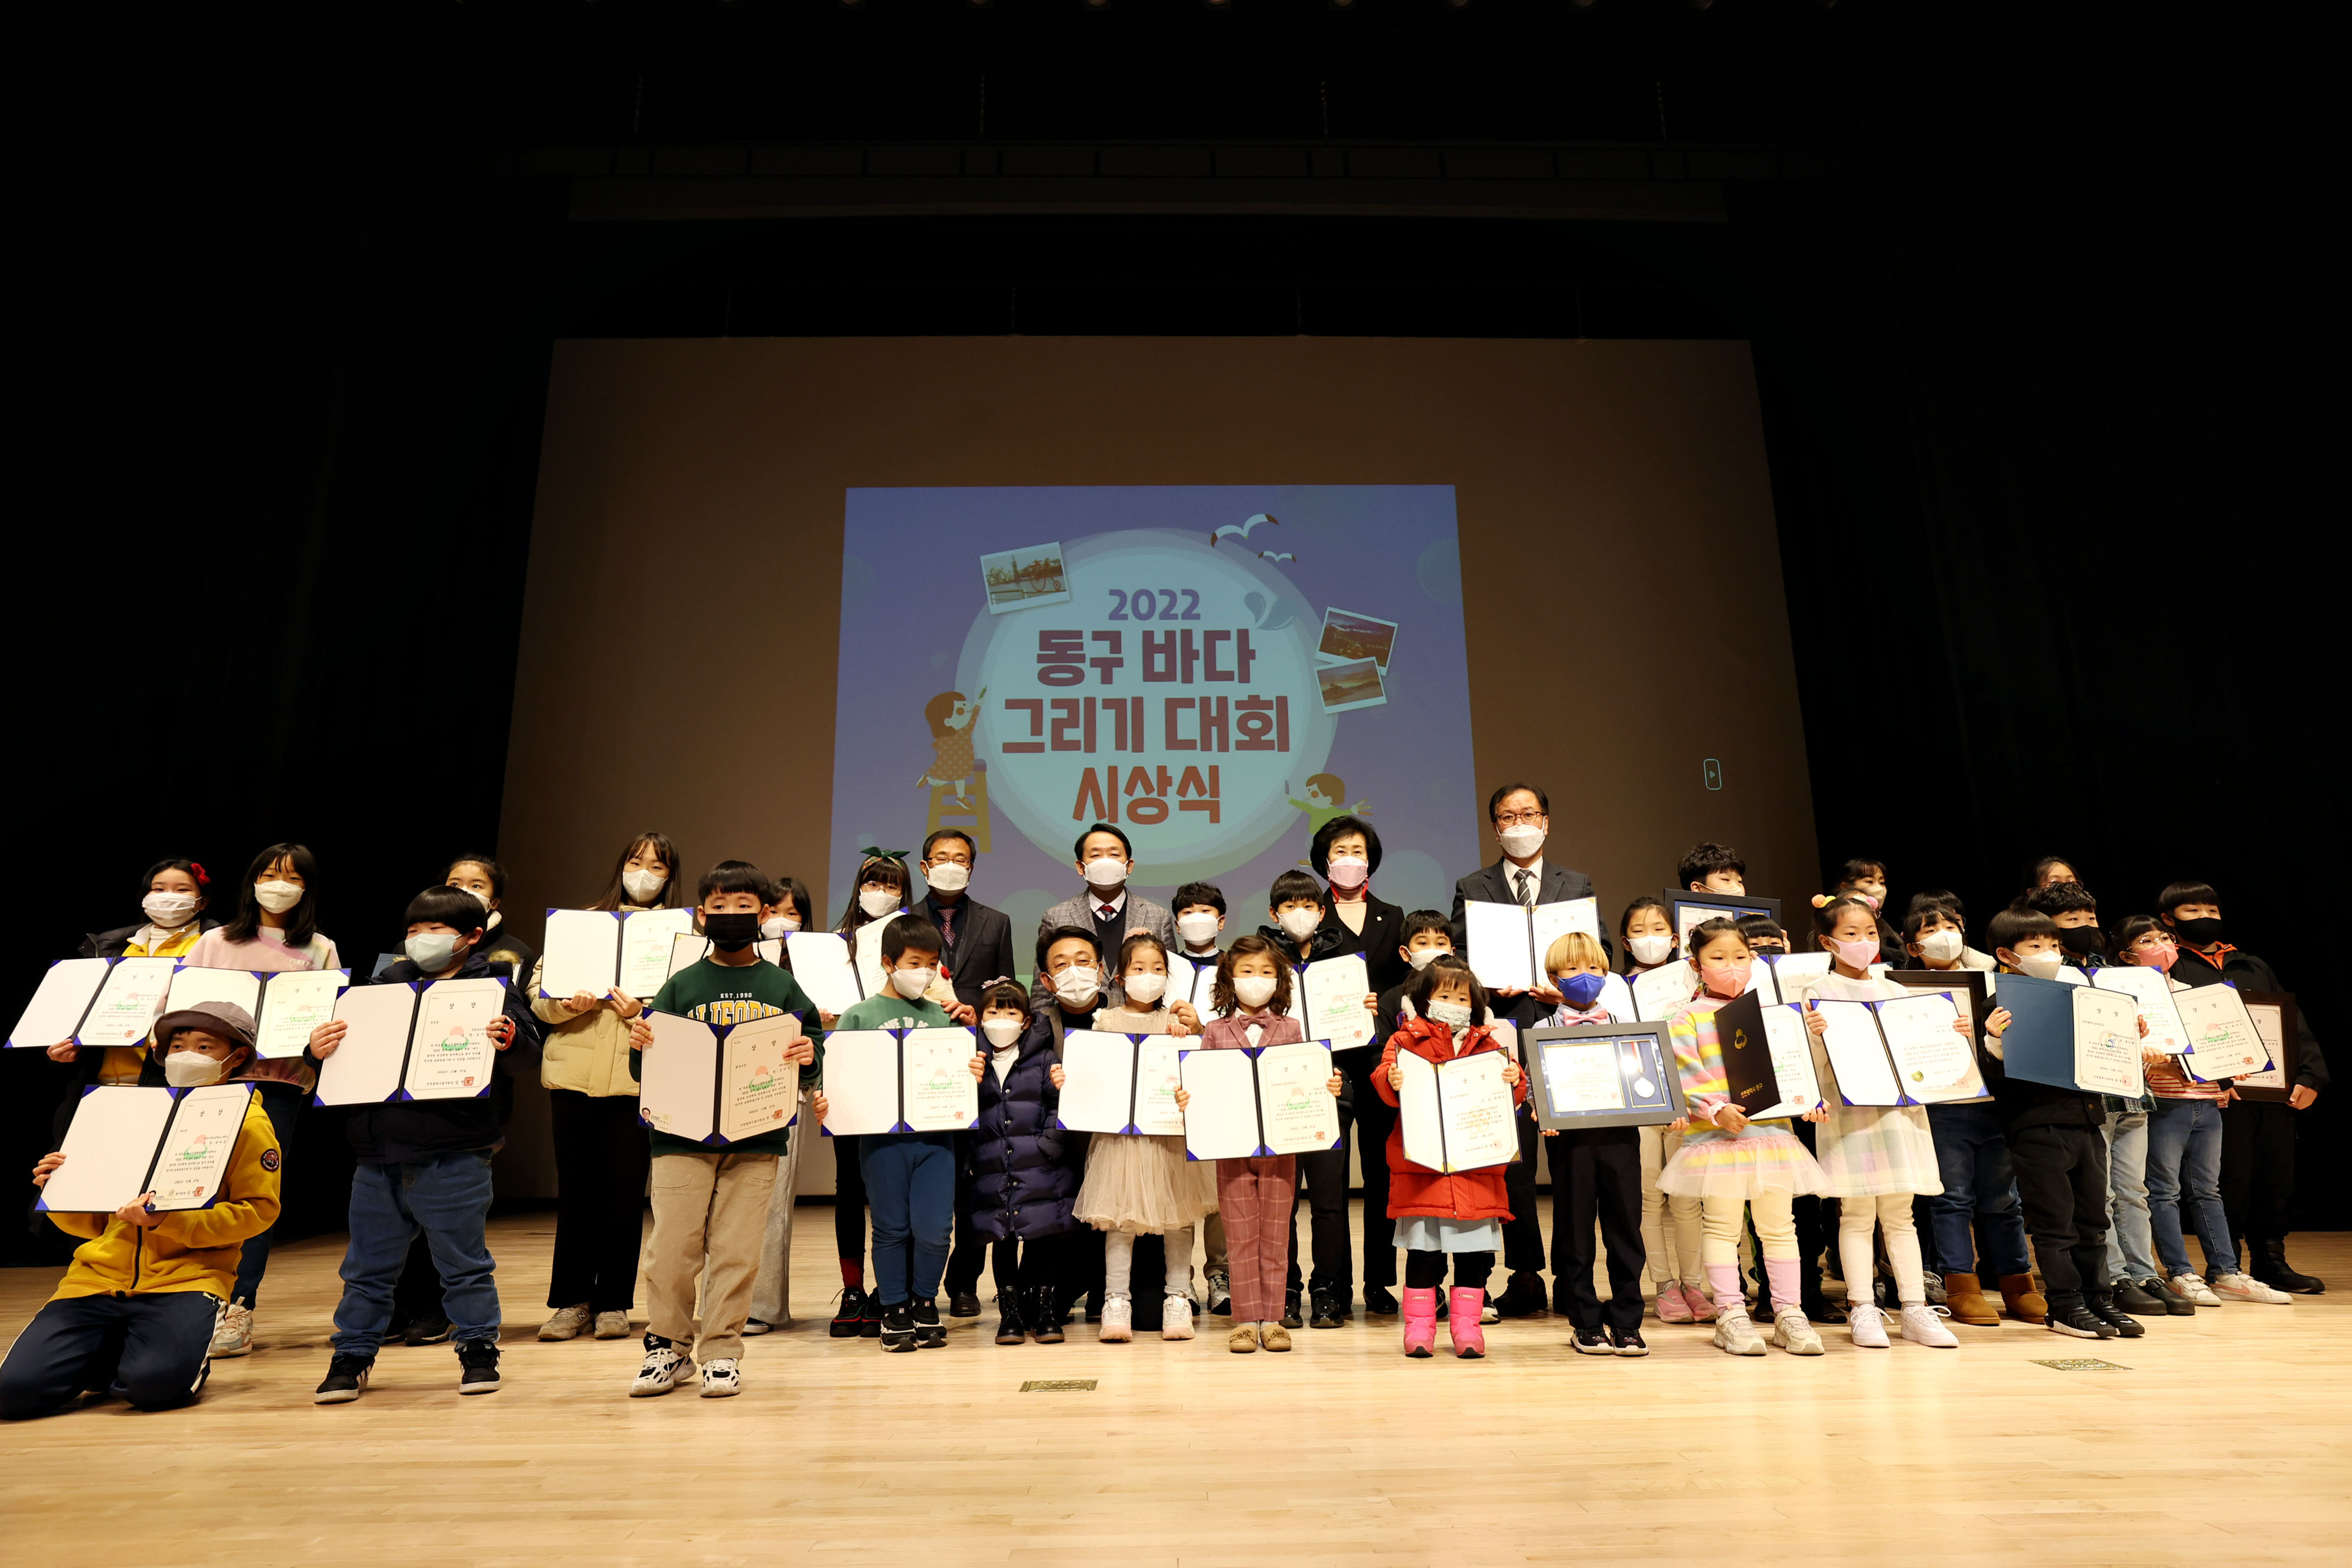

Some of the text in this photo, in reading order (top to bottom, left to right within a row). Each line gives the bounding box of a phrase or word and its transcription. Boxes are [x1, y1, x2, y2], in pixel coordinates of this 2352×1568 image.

[1108, 589, 1201, 621] 2022
[1037, 629, 1256, 687] 동구 바다
[1002, 694, 1290, 754] 그리기 대회
[1072, 765, 1220, 825] 시상식
[577, 1311, 587, 1321] N
